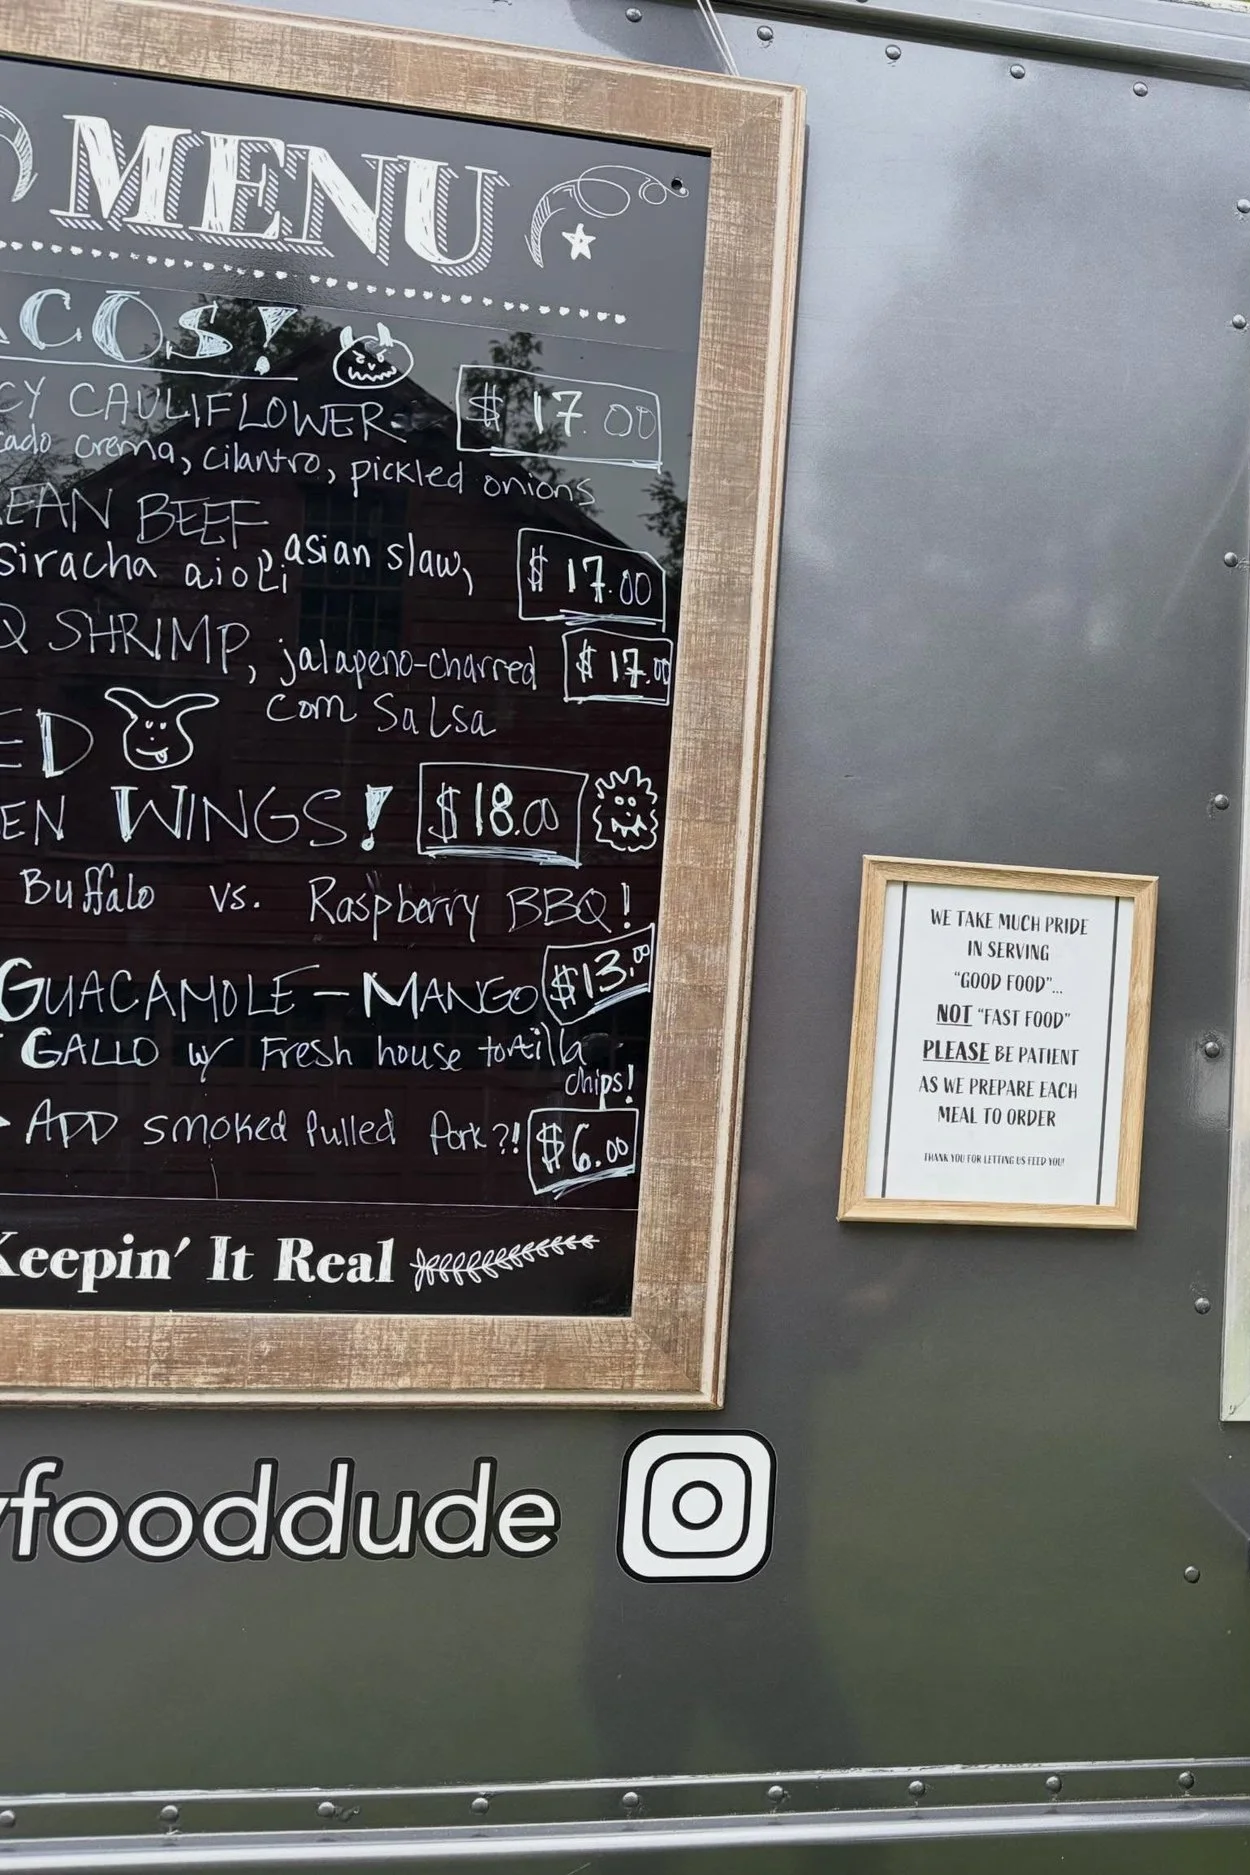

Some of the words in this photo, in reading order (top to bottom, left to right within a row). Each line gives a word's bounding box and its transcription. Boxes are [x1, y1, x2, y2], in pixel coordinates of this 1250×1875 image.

[50, 114, 510, 277] MENU
[0, 289, 298, 374] COS!
[70, 383, 407, 442] CAULIFLOWER
[75, 433, 192, 475] crema,
[203, 442, 336, 484] cilantro,
[351, 456, 463, 498] pickled
[484, 474, 595, 505] onions
[137, 493, 269, 549] BEEF
[284, 533, 371, 567] asian
[388, 533, 473, 595] slaw,
[111, 785, 392, 851] WINGS!
[20, 863, 154, 914] Buffalo
[209, 882, 260, 912] vs.
[507, 883, 631, 933] BBQ!
[930, 909, 952, 926] WE
[957, 910, 993, 928] TAKE
[999, 913, 1040, 932] MUCH
[1045, 916, 1088, 935] PRIDE
[968, 940, 982, 957] IN
[988, 941, 1049, 961] SERVING
[0, 957, 319, 1022] GUACAMOLE
[363, 972, 538, 1019] MANGO
[936, 1004, 973, 1025] NOT
[21, 1027, 159, 1069] GALLO
[261, 1035, 352, 1071] Fresh
[378, 1036, 462, 1071] house
[923, 1039, 990, 1063] PLEASE
[995, 1045, 1014, 1062] BE
[1019, 1047, 1079, 1066] PATIENT
[565, 1065, 634, 1110] chips!
[919, 1076, 938, 1093] AS
[943, 1077, 964, 1094] WE
[970, 1078, 1035, 1097] PREPARE
[1040, 1080, 1078, 1099] EACH
[25, 1099, 118, 1148] ADD
[938, 1106, 977, 1124] MEAL
[984, 1107, 1001, 1125] TO
[1007, 1109, 1056, 1127] ORDER
[924, 1152, 948, 1162] THANK
[950, 1153, 964, 1163] YOU
[967, 1154, 982, 1163] FOR
[984, 1154, 1015, 1165] LETTING
[1027, 1156, 1046, 1166] FEED
[206, 1236, 254, 1283] It
[274, 1237, 395, 1284] Real
